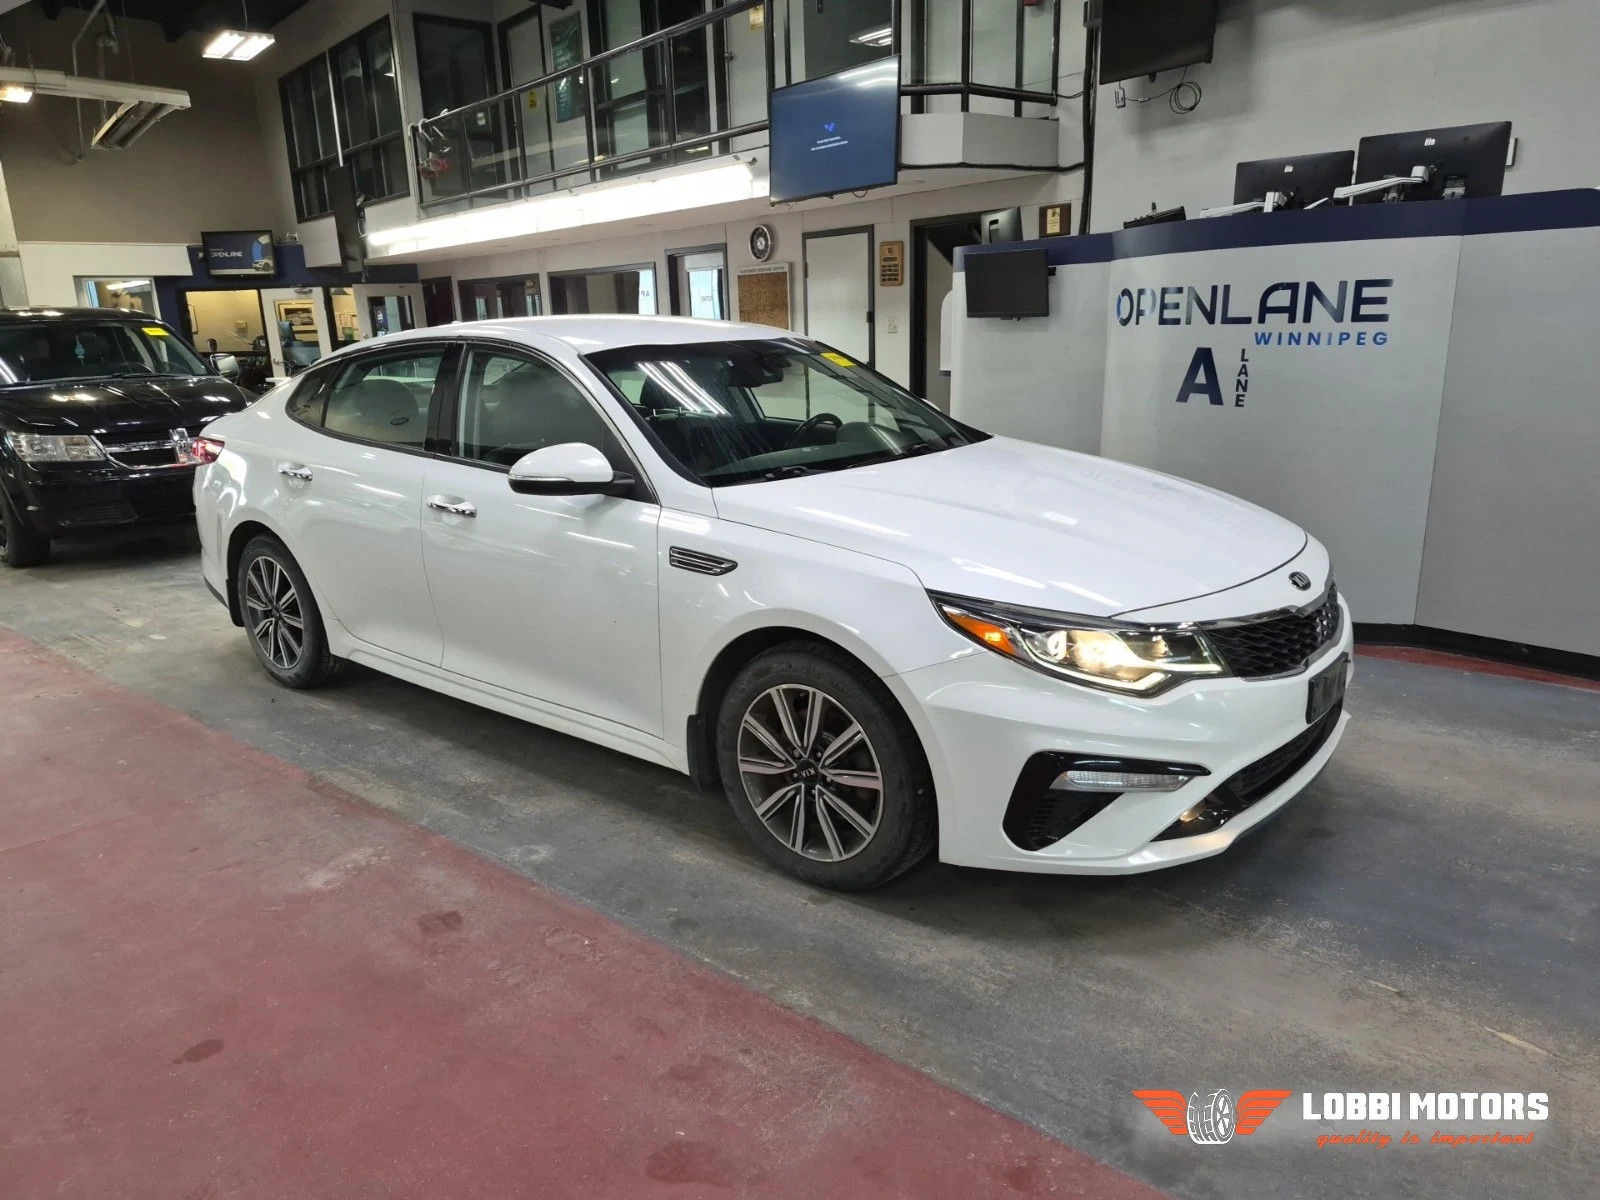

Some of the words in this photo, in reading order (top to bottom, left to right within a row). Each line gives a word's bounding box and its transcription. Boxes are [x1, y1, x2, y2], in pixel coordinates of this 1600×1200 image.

[1116, 278, 1393, 327] OPENLANE
[1254, 331, 1389, 346] WINNIPEG
[1175, 346, 1224, 406] A
[1234, 348, 1250, 408] LANE
[800, 767, 816, 778] KIA
